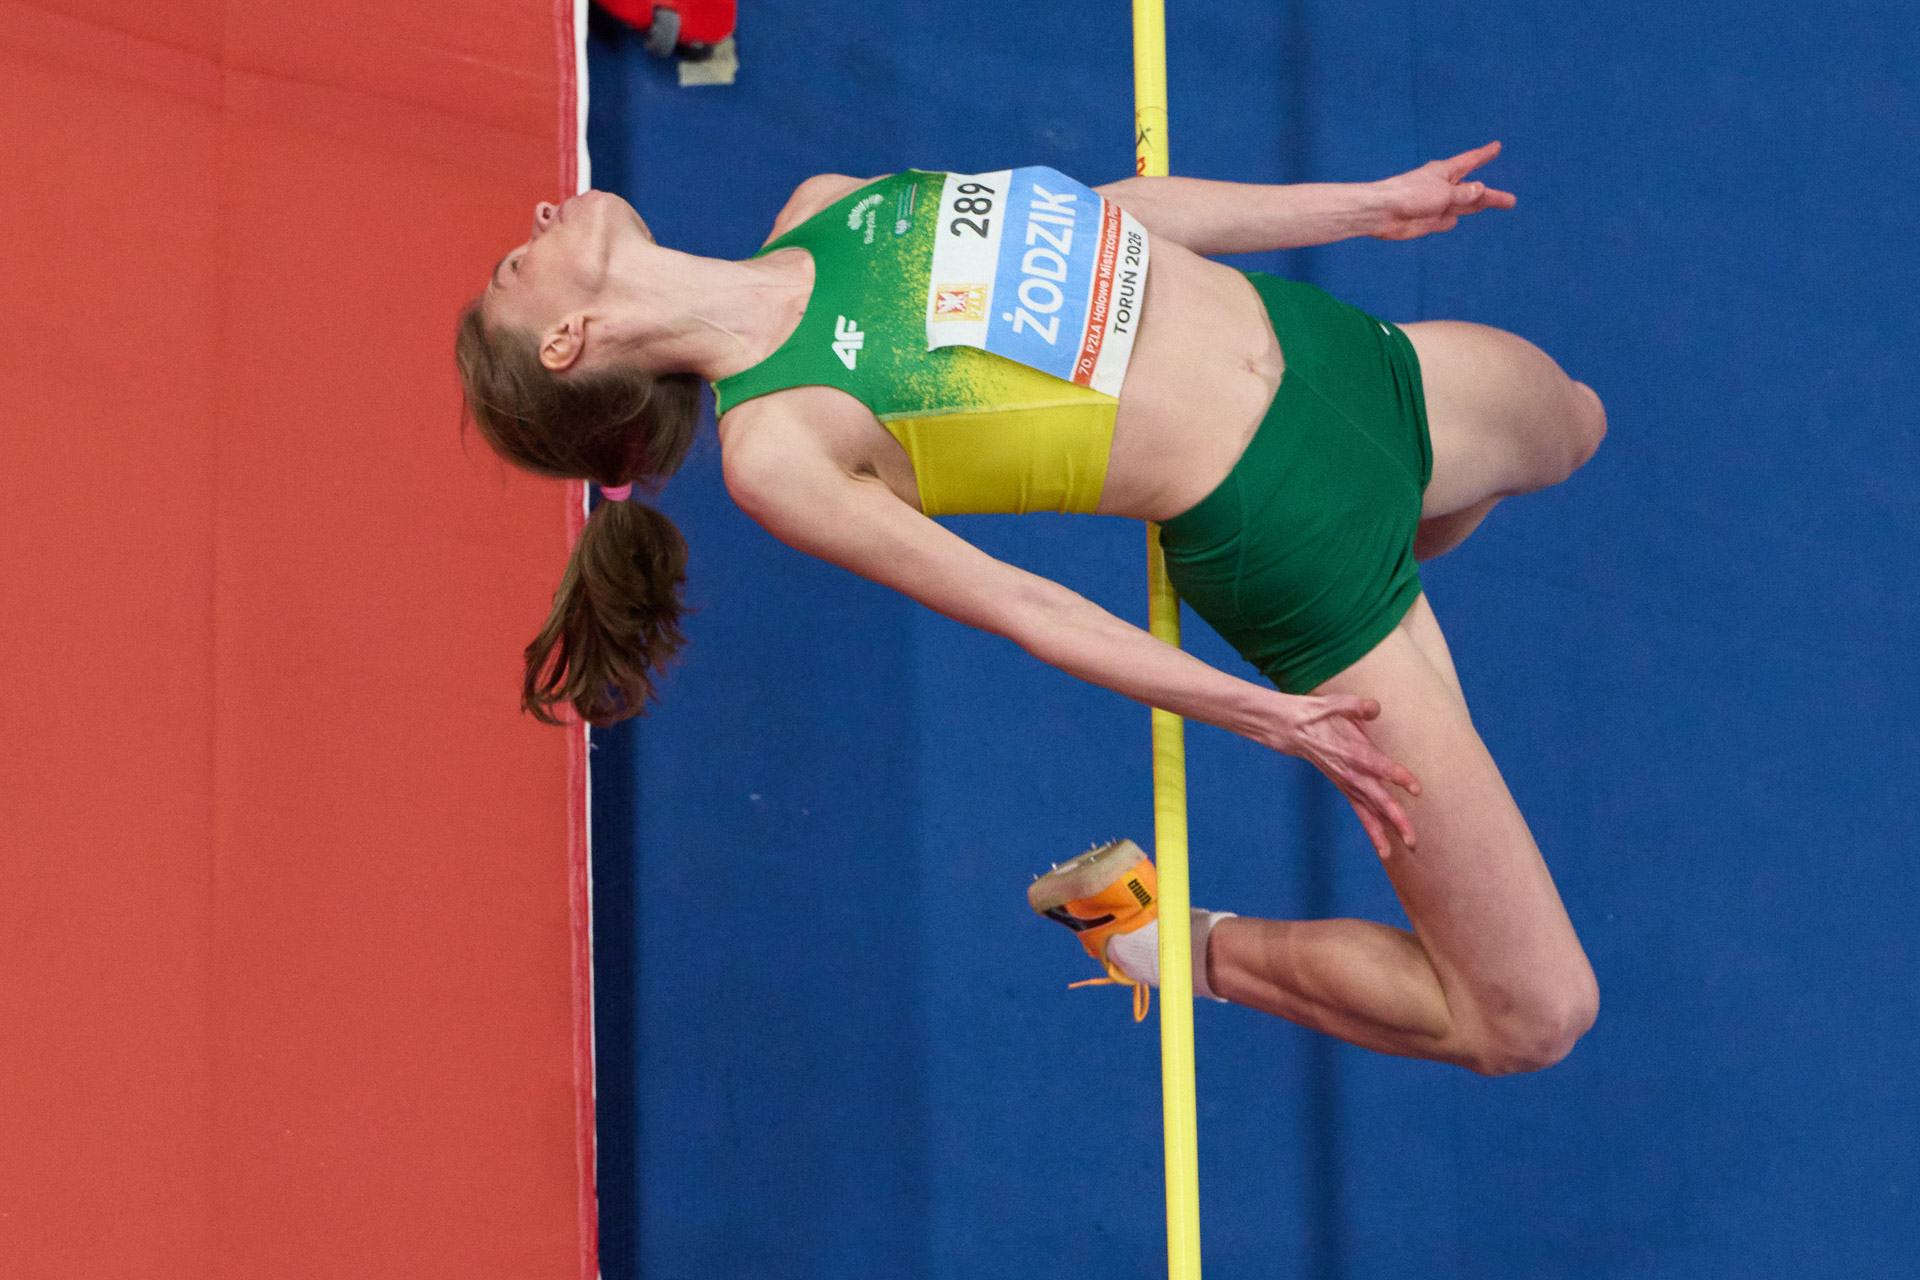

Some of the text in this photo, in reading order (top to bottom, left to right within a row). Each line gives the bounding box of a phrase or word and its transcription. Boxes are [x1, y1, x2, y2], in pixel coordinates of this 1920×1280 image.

[950, 182, 995, 239] 289
[1002, 183, 1078, 346] ŻODZIK
[1099, 218, 1119, 279] Mistrzostwa
[966, 285, 985, 320] PZLA
[1092, 280, 1110, 323] Halowe
[1113, 231, 1142, 334] TORUŃ 2026
[831, 314, 865, 371] 4F
[1085, 324, 1103, 354] PZLA
